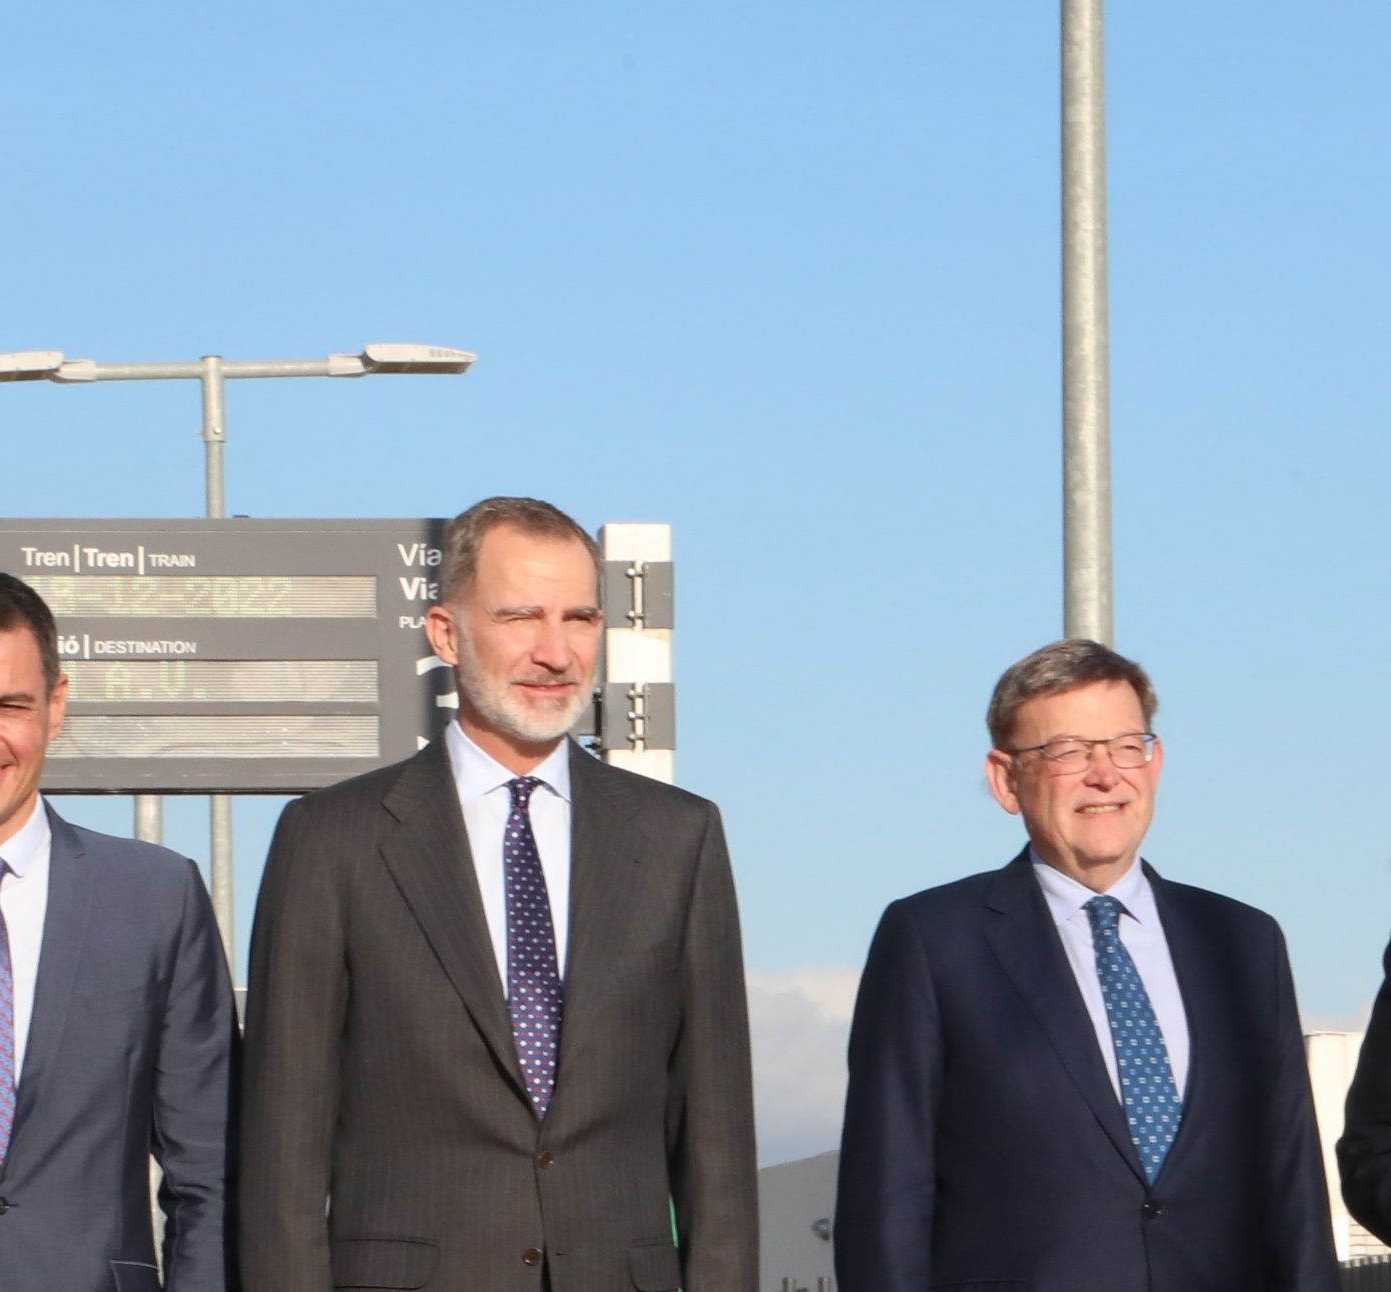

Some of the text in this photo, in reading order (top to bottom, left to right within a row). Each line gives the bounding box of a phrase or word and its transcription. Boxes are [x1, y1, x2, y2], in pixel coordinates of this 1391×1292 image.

[20, 546, 196, 568] Tren Tren TRAIN
[93, 640, 197, 655] DESTINATION
